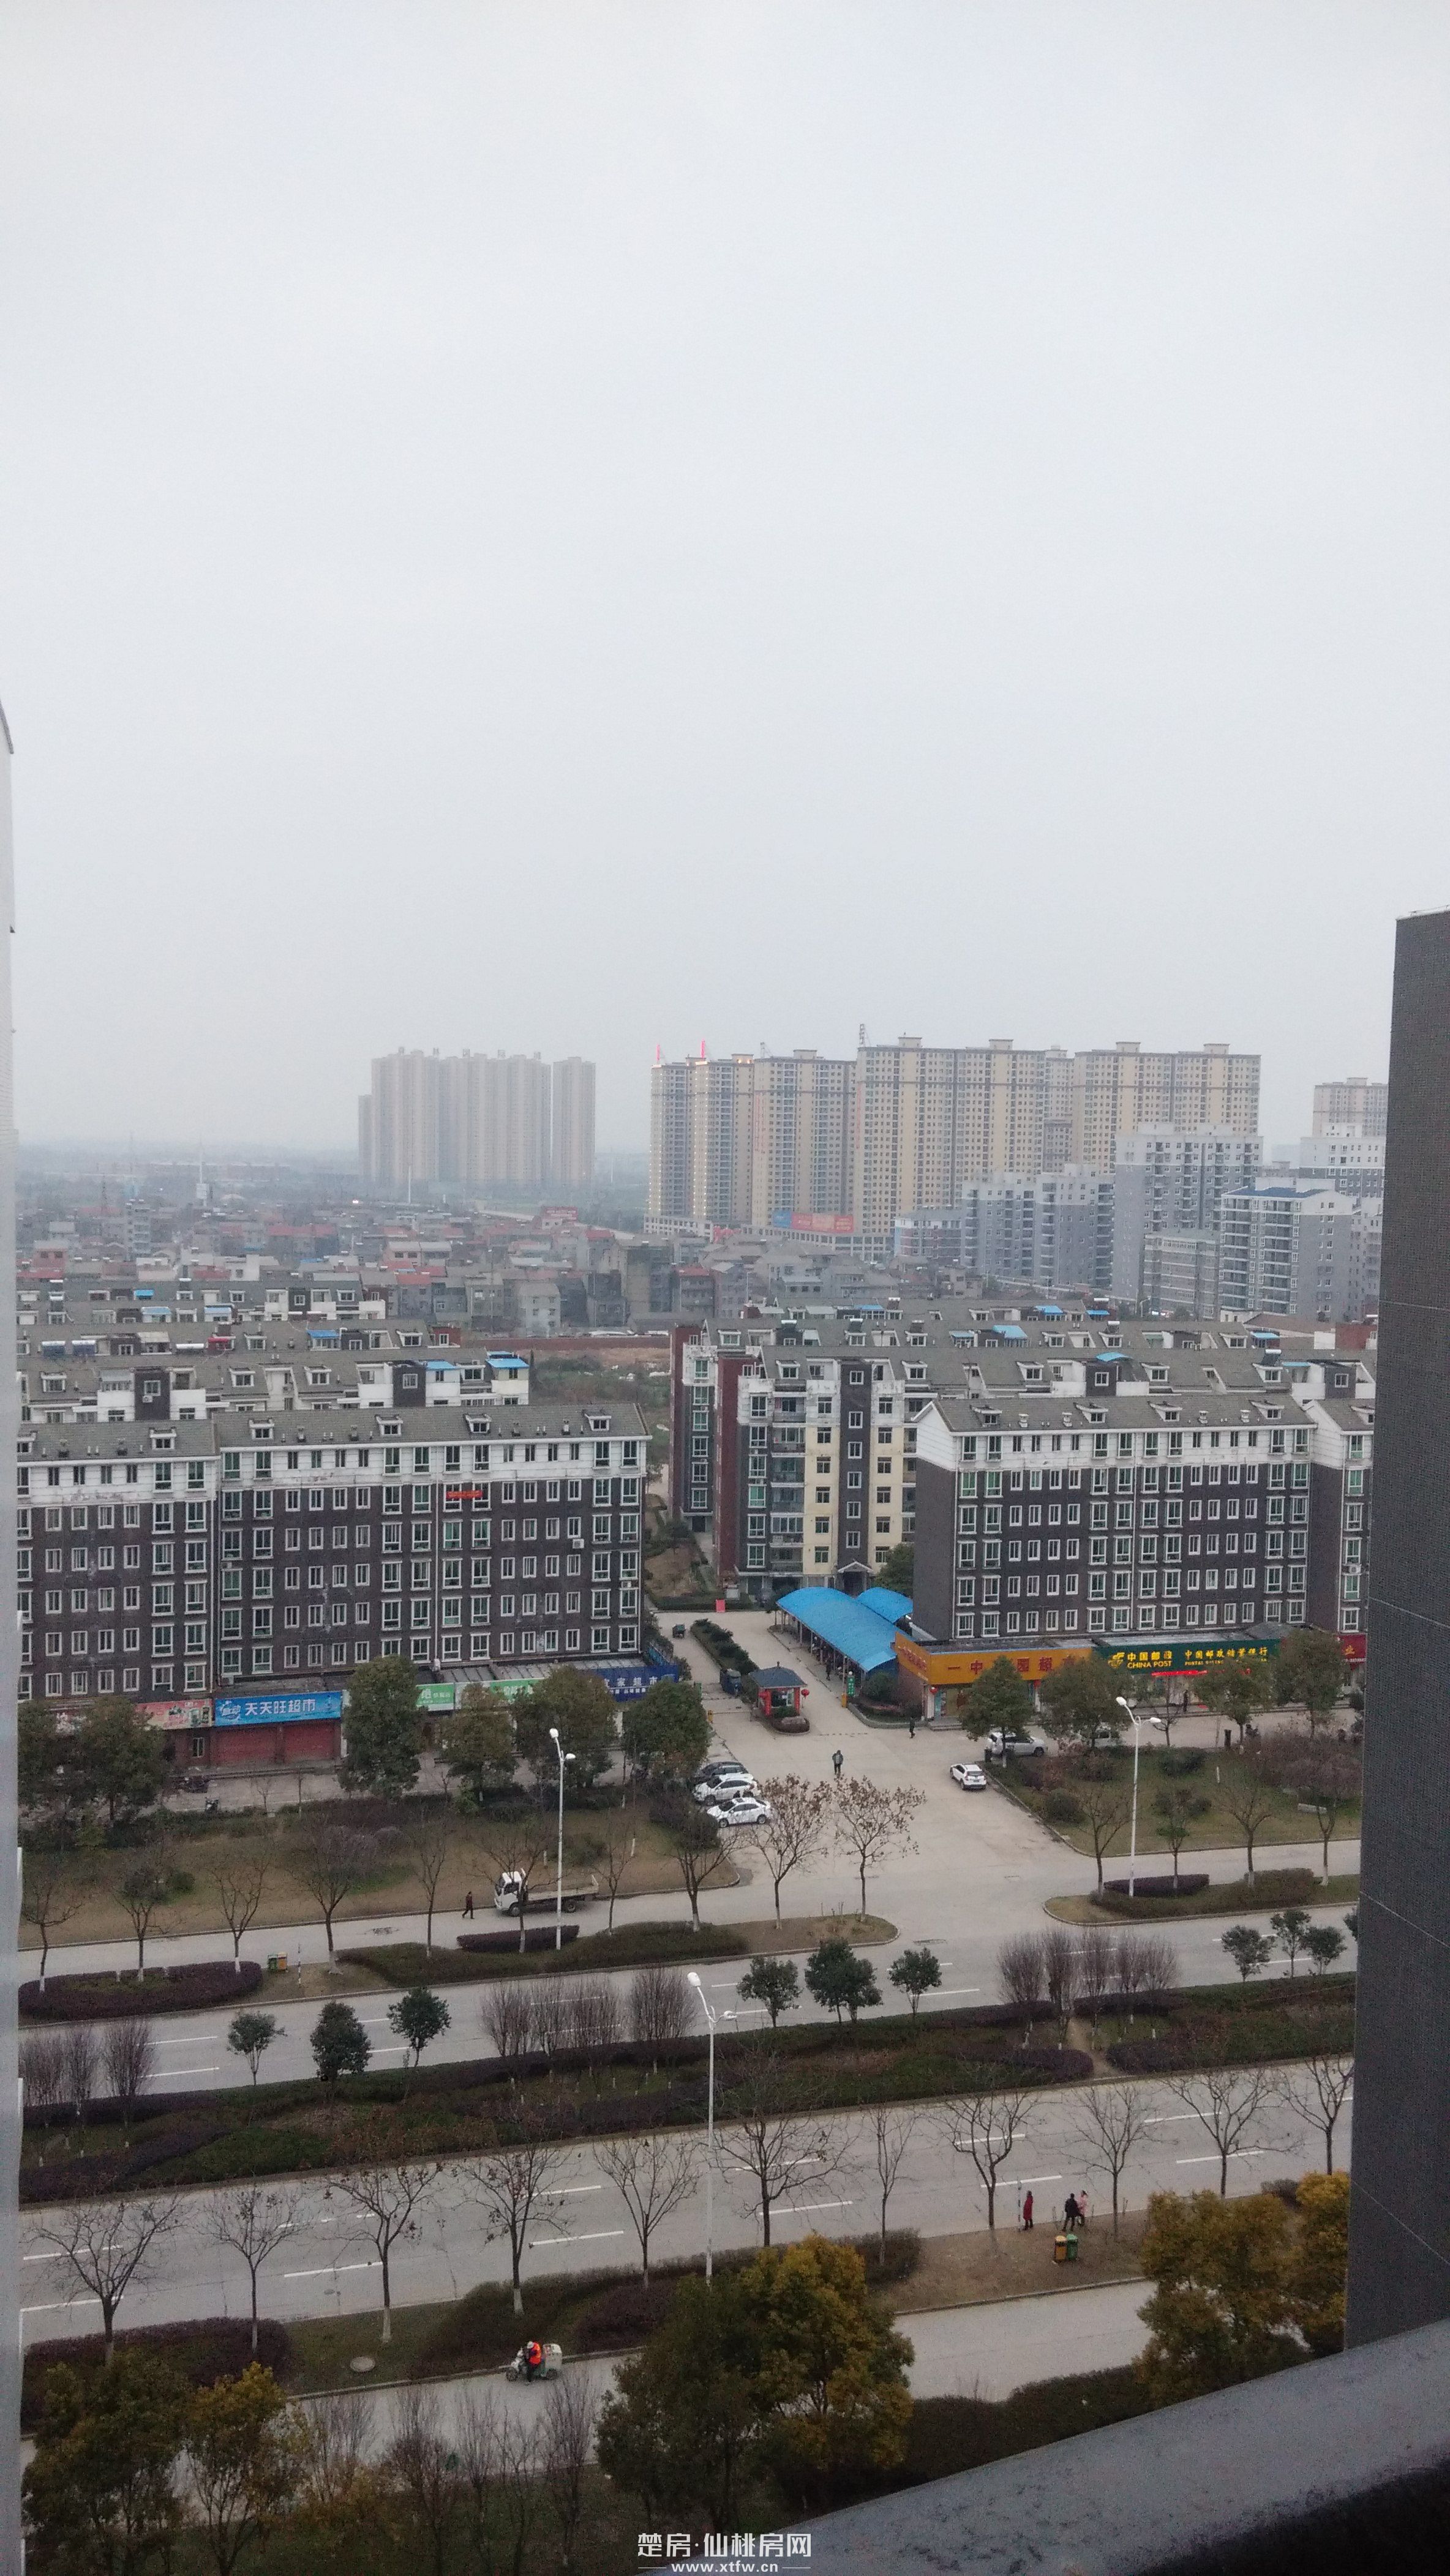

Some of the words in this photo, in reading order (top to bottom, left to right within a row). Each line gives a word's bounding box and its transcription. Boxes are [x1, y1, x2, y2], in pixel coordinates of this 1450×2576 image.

[1127, 1650, 1172, 1661] 中国邮政
[245, 1698, 316, 1716] 天天旺超市
